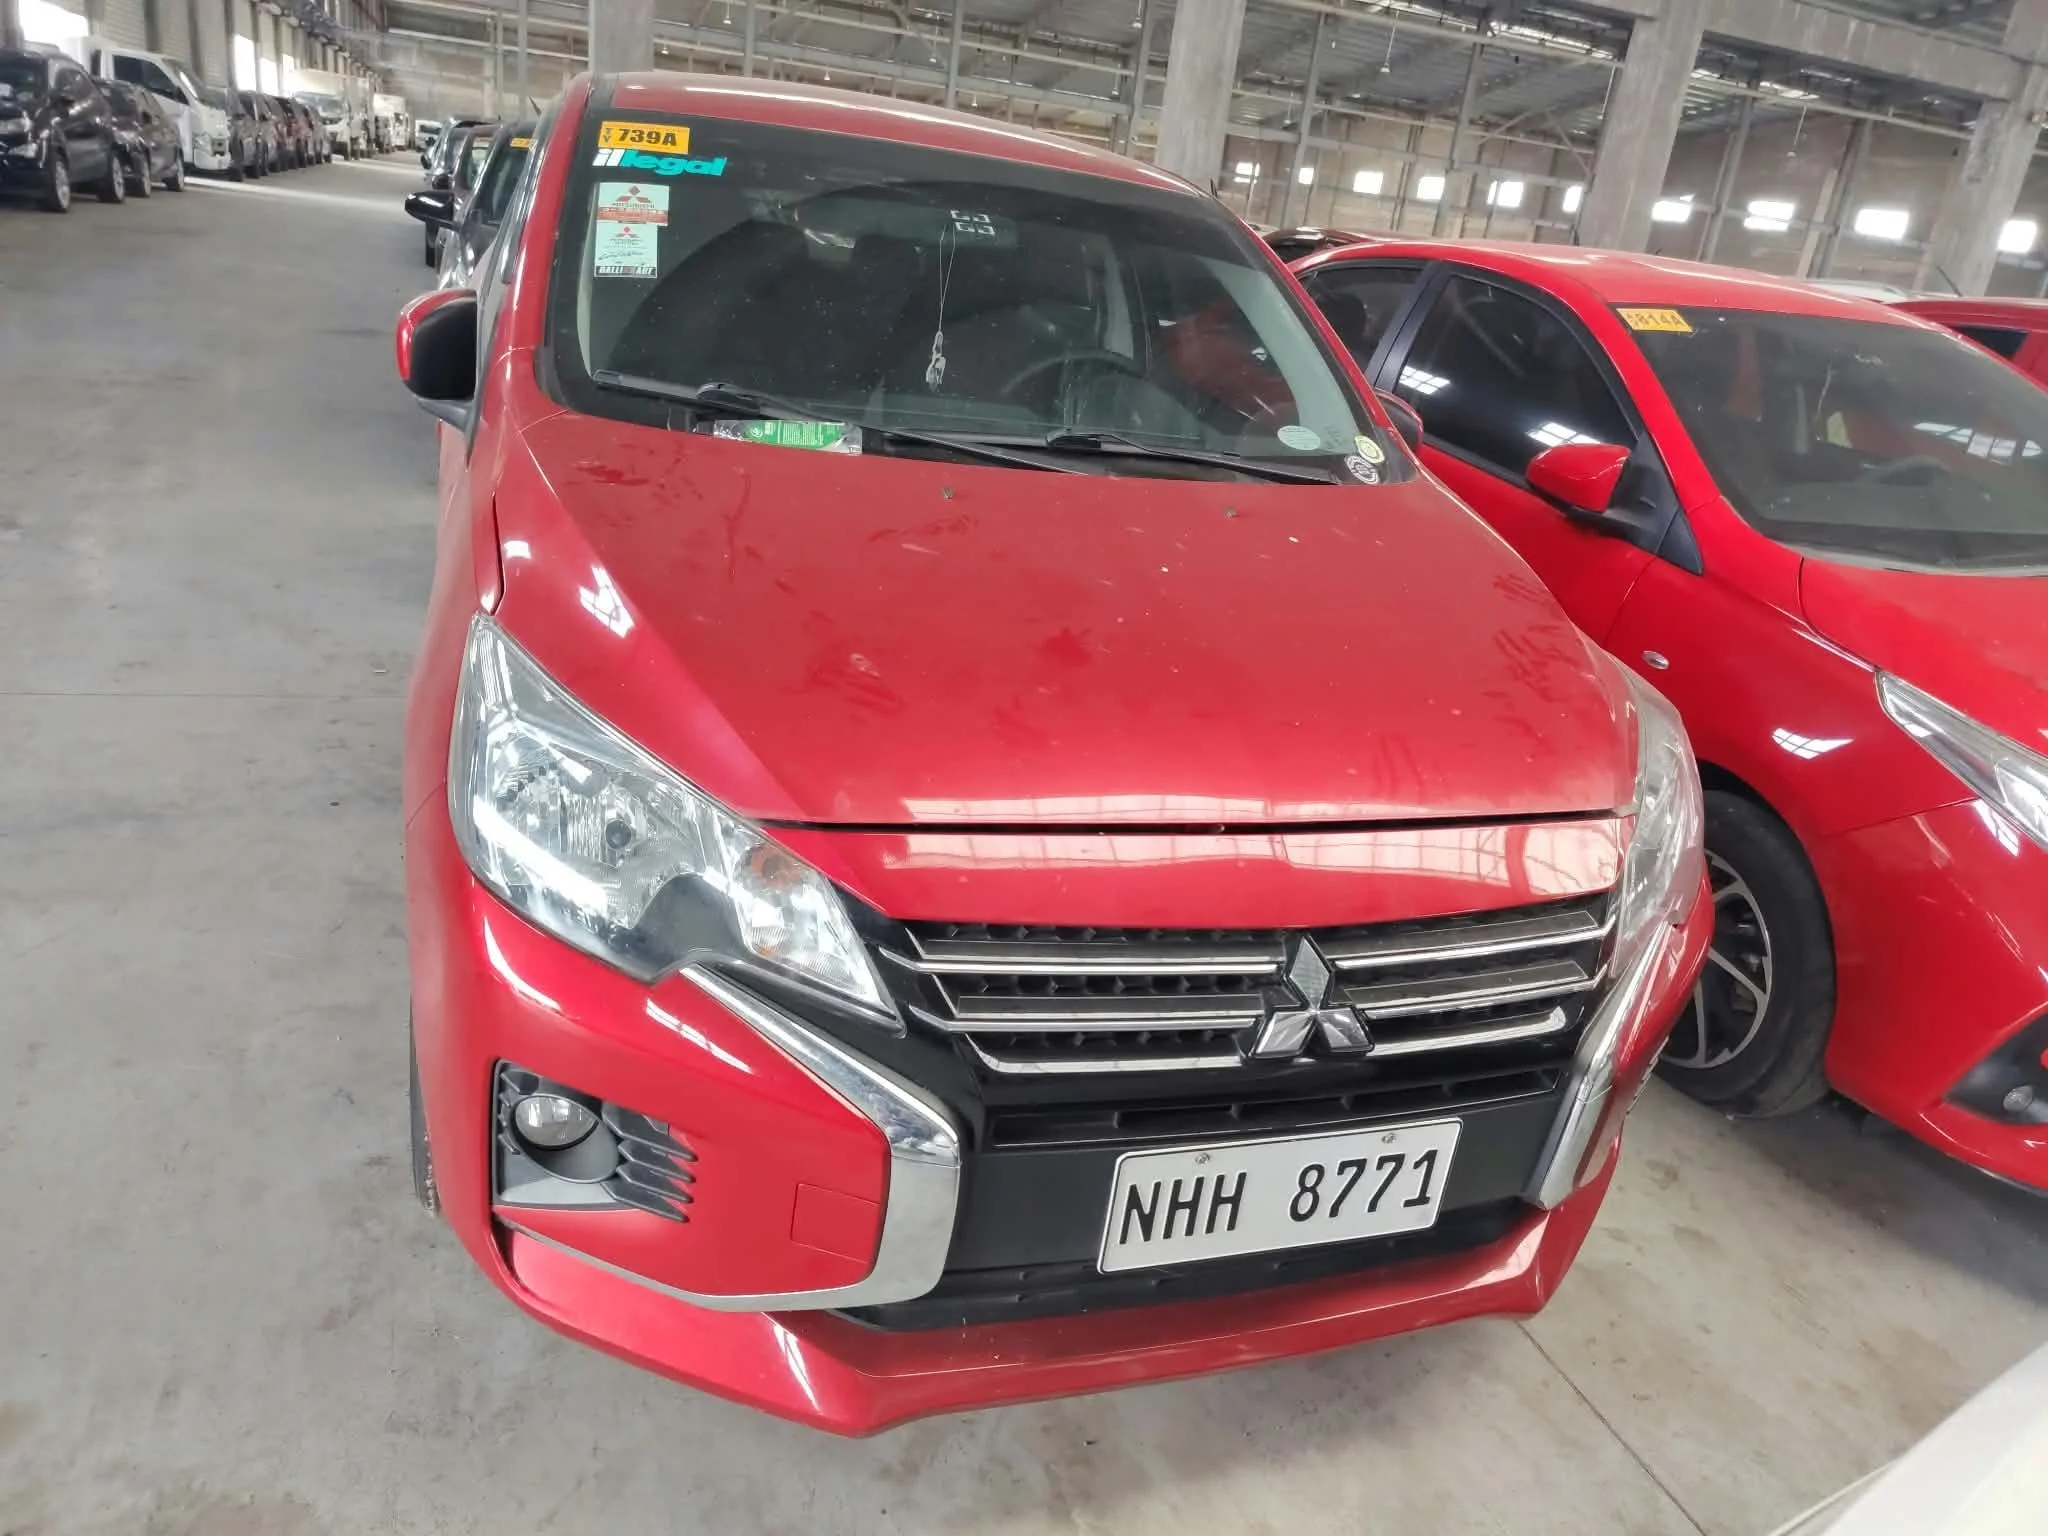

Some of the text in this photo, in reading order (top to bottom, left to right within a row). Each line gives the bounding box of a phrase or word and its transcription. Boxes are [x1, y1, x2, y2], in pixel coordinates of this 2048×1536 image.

[618, 129, 677, 146] 739A
[1119, 1149, 1438, 1245] NHH 8771
